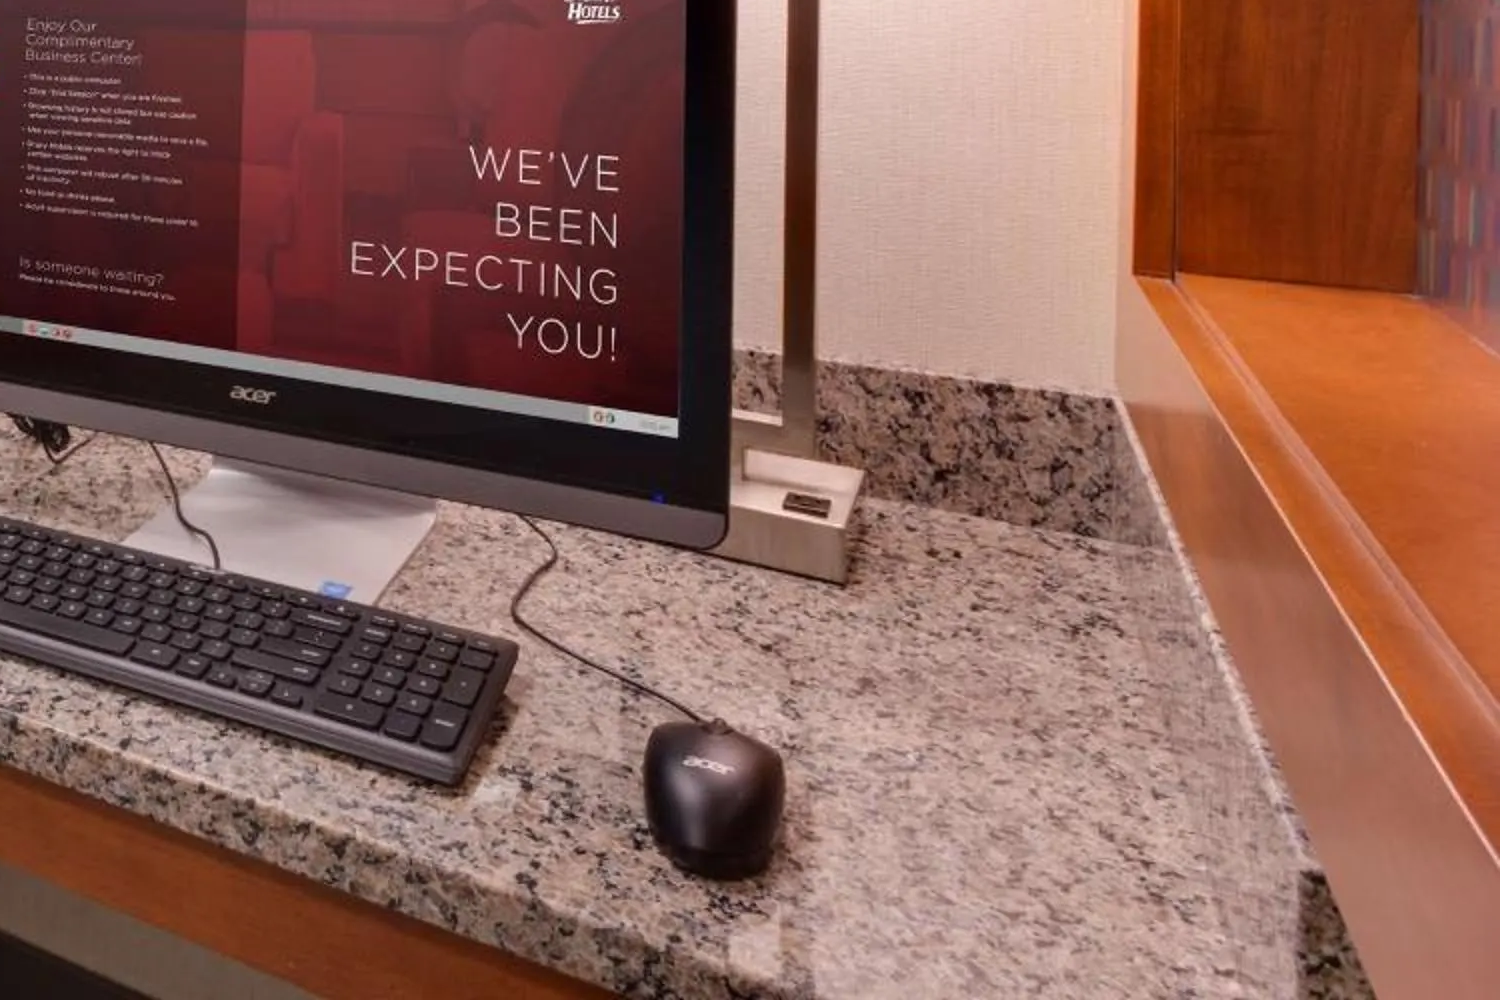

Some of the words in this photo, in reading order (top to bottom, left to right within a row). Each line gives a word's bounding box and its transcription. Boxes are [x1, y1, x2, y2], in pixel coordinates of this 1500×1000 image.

[26, 17, 66, 33] Enjoy
[69, 18, 97, 32] Our
[26, 33, 135, 50] Complimentary
[25, 48, 87, 64] Business
[469, 145, 620, 193] WE'VE
[495, 201, 618, 249] BEEN
[19, 255, 32, 269] Is
[35, 260, 100, 278] someone
[104, 268, 166, 288] waiting?
[350, 240, 618, 306] EXPECTING
[506, 312, 617, 362] YOU!
[230, 385, 277, 405] acer
